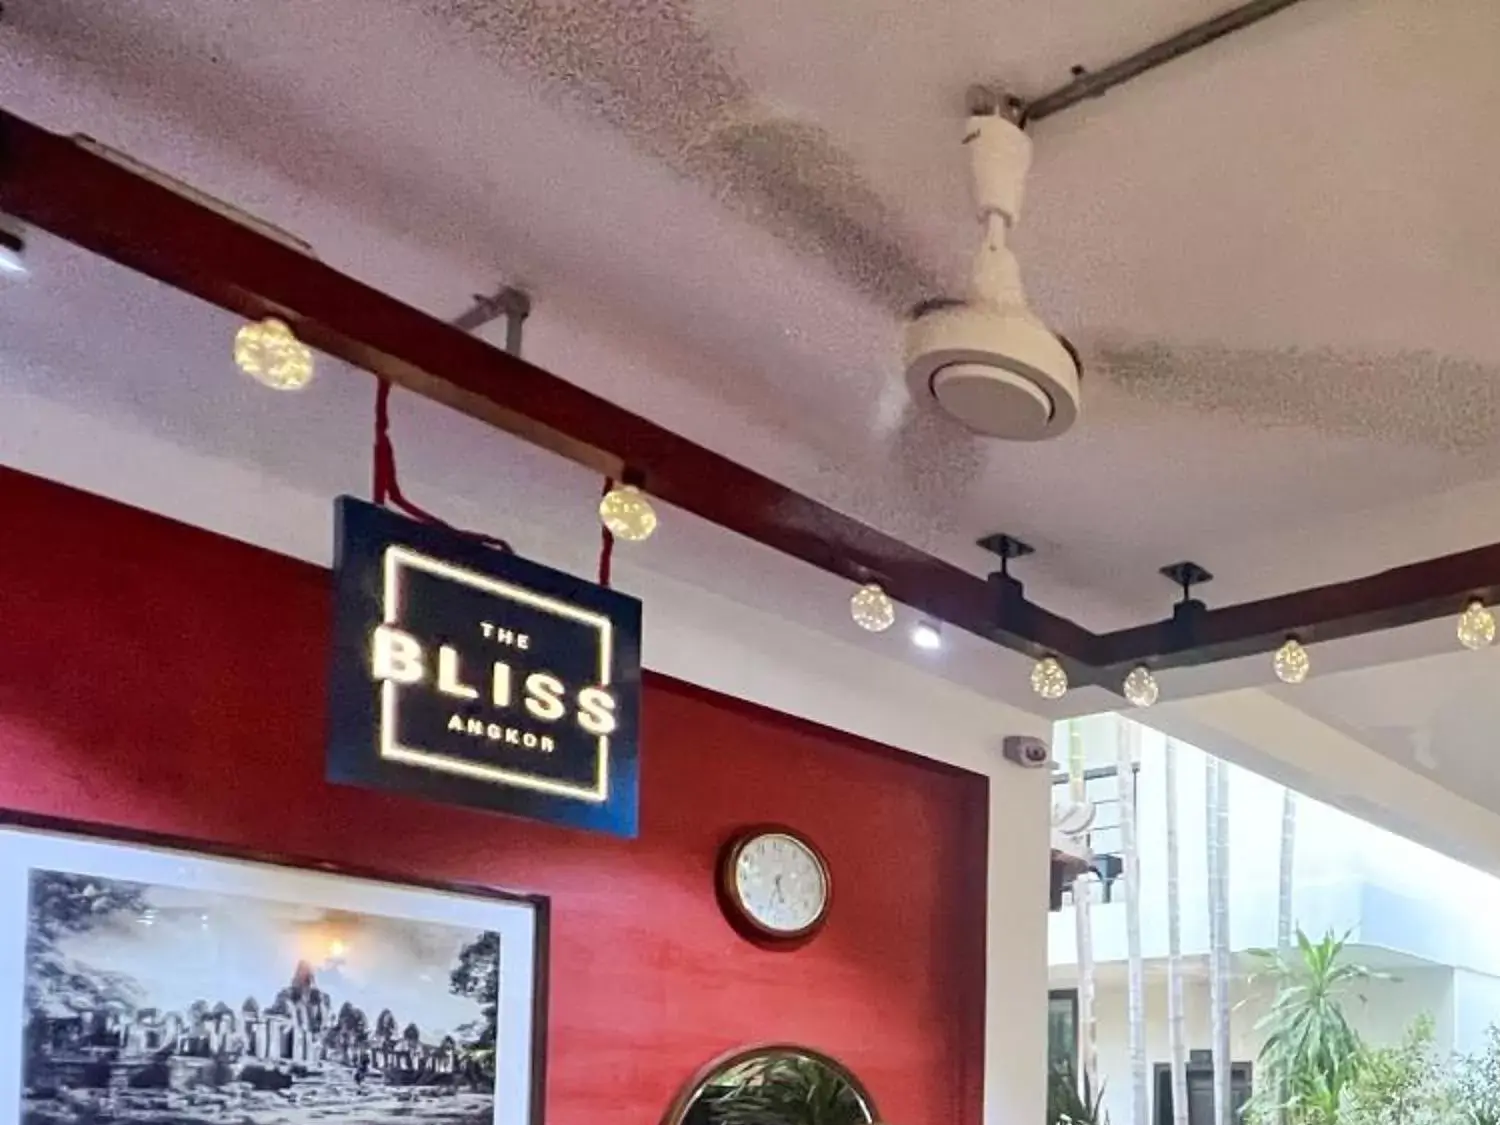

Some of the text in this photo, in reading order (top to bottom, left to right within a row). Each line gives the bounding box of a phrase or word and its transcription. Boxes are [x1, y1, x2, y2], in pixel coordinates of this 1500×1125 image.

[480, 621, 529, 650] THE
[372, 624, 616, 734] BLISS
[447, 715, 555, 753] ANGKOR
